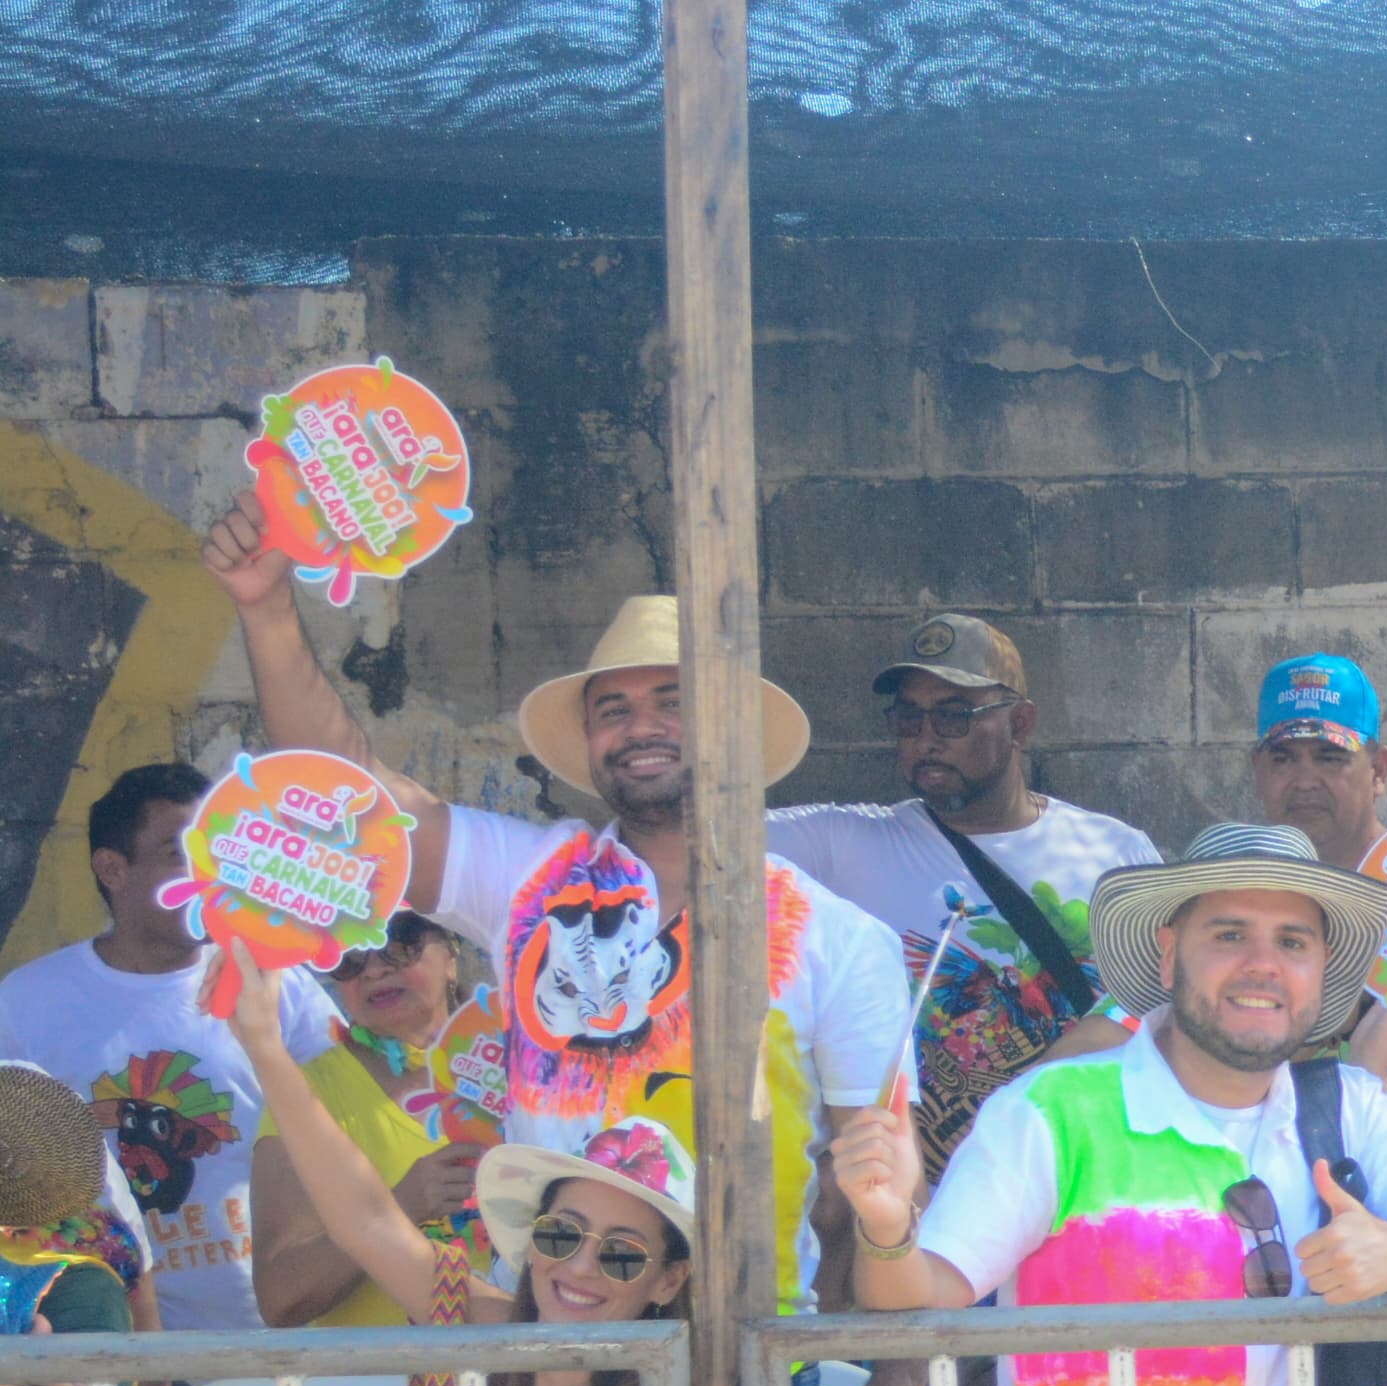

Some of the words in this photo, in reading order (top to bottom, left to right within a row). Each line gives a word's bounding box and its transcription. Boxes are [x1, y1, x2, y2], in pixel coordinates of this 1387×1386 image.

[382, 409, 421, 461] ara
[303, 461, 359, 538] BACANO
[318, 440, 393, 553] CARNAVAL
[364, 468, 418, 528] JOO!
[1278, 688, 1340, 705] DISFRUTAR
[284, 788, 338, 821] ara
[250, 849, 369, 916] CARNAVAL
[307, 844, 374, 887] JOO!
[250, 876, 335, 924] BACANO
